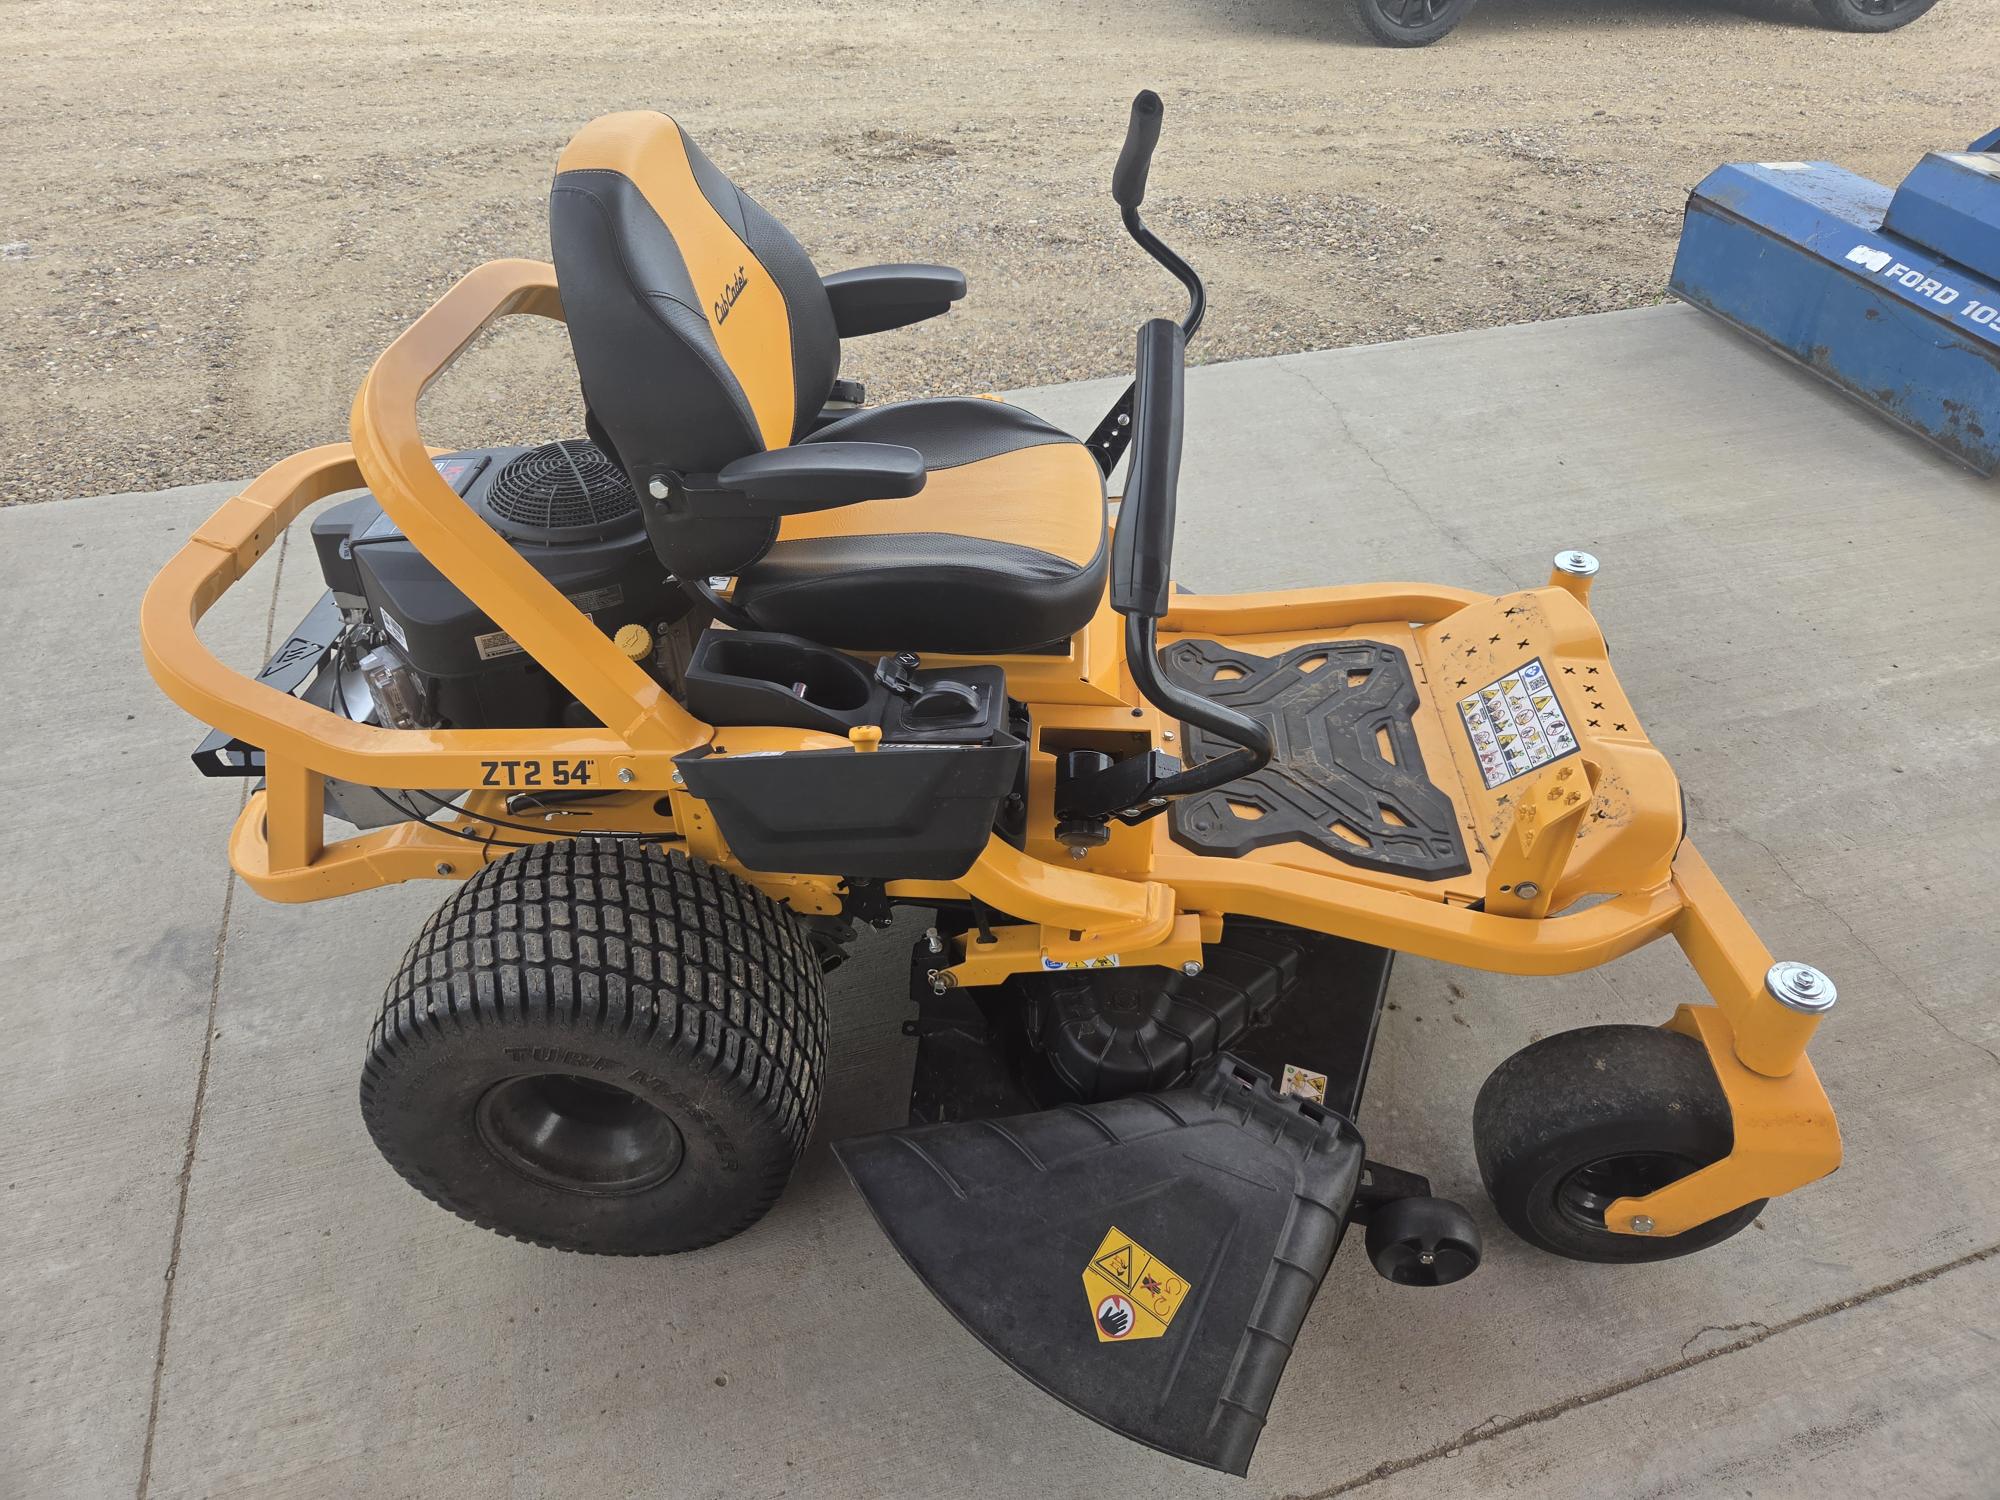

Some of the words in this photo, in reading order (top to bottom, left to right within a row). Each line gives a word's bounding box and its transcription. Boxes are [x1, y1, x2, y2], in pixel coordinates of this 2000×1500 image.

[714, 293, 729, 325] Cub
[725, 265, 748, 307] Cadet
[1884, 262, 1960, 305] FORD
[481, 761, 541, 786] ZT2
[552, 760, 594, 786] 54"
[502, 1046, 627, 1071] TURF
